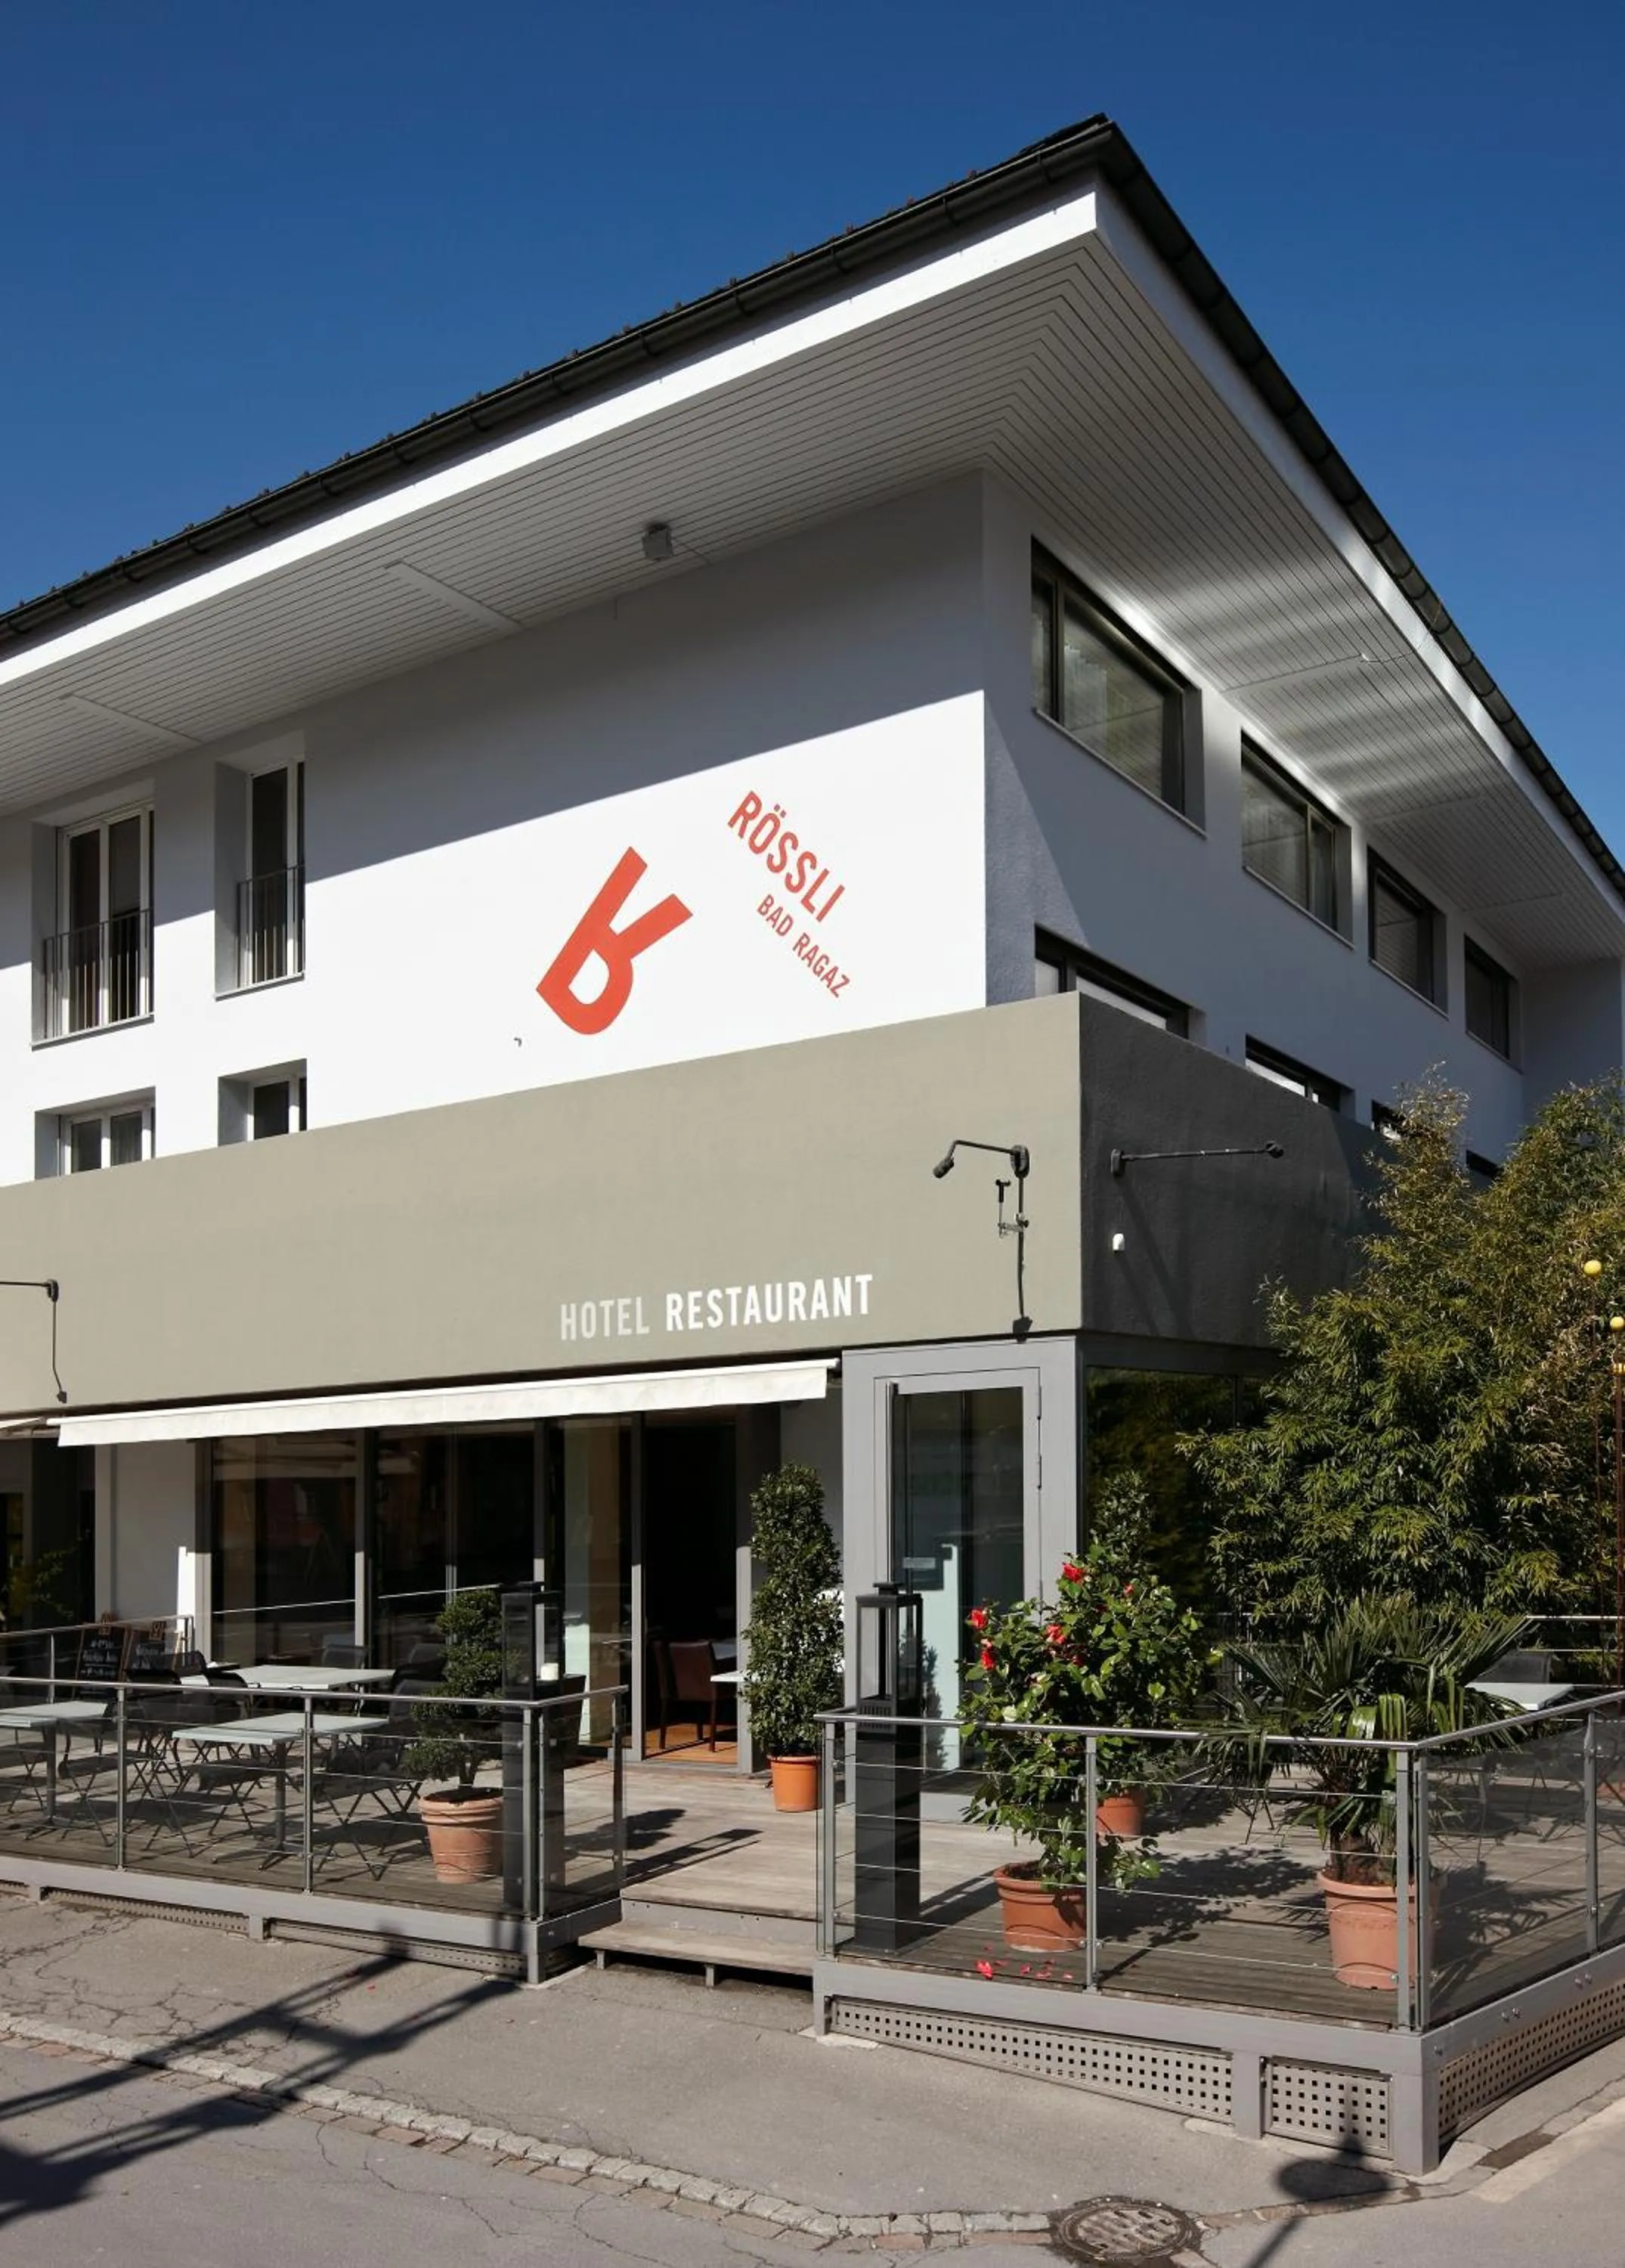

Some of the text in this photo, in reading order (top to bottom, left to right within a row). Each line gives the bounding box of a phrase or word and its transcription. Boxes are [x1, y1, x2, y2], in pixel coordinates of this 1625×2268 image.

[728, 791, 844, 922] RÖSSLI
[757, 894, 850, 998] BAD RAGAZ
[560, 1273, 874, 1340] HOTEL RESTAURANT
